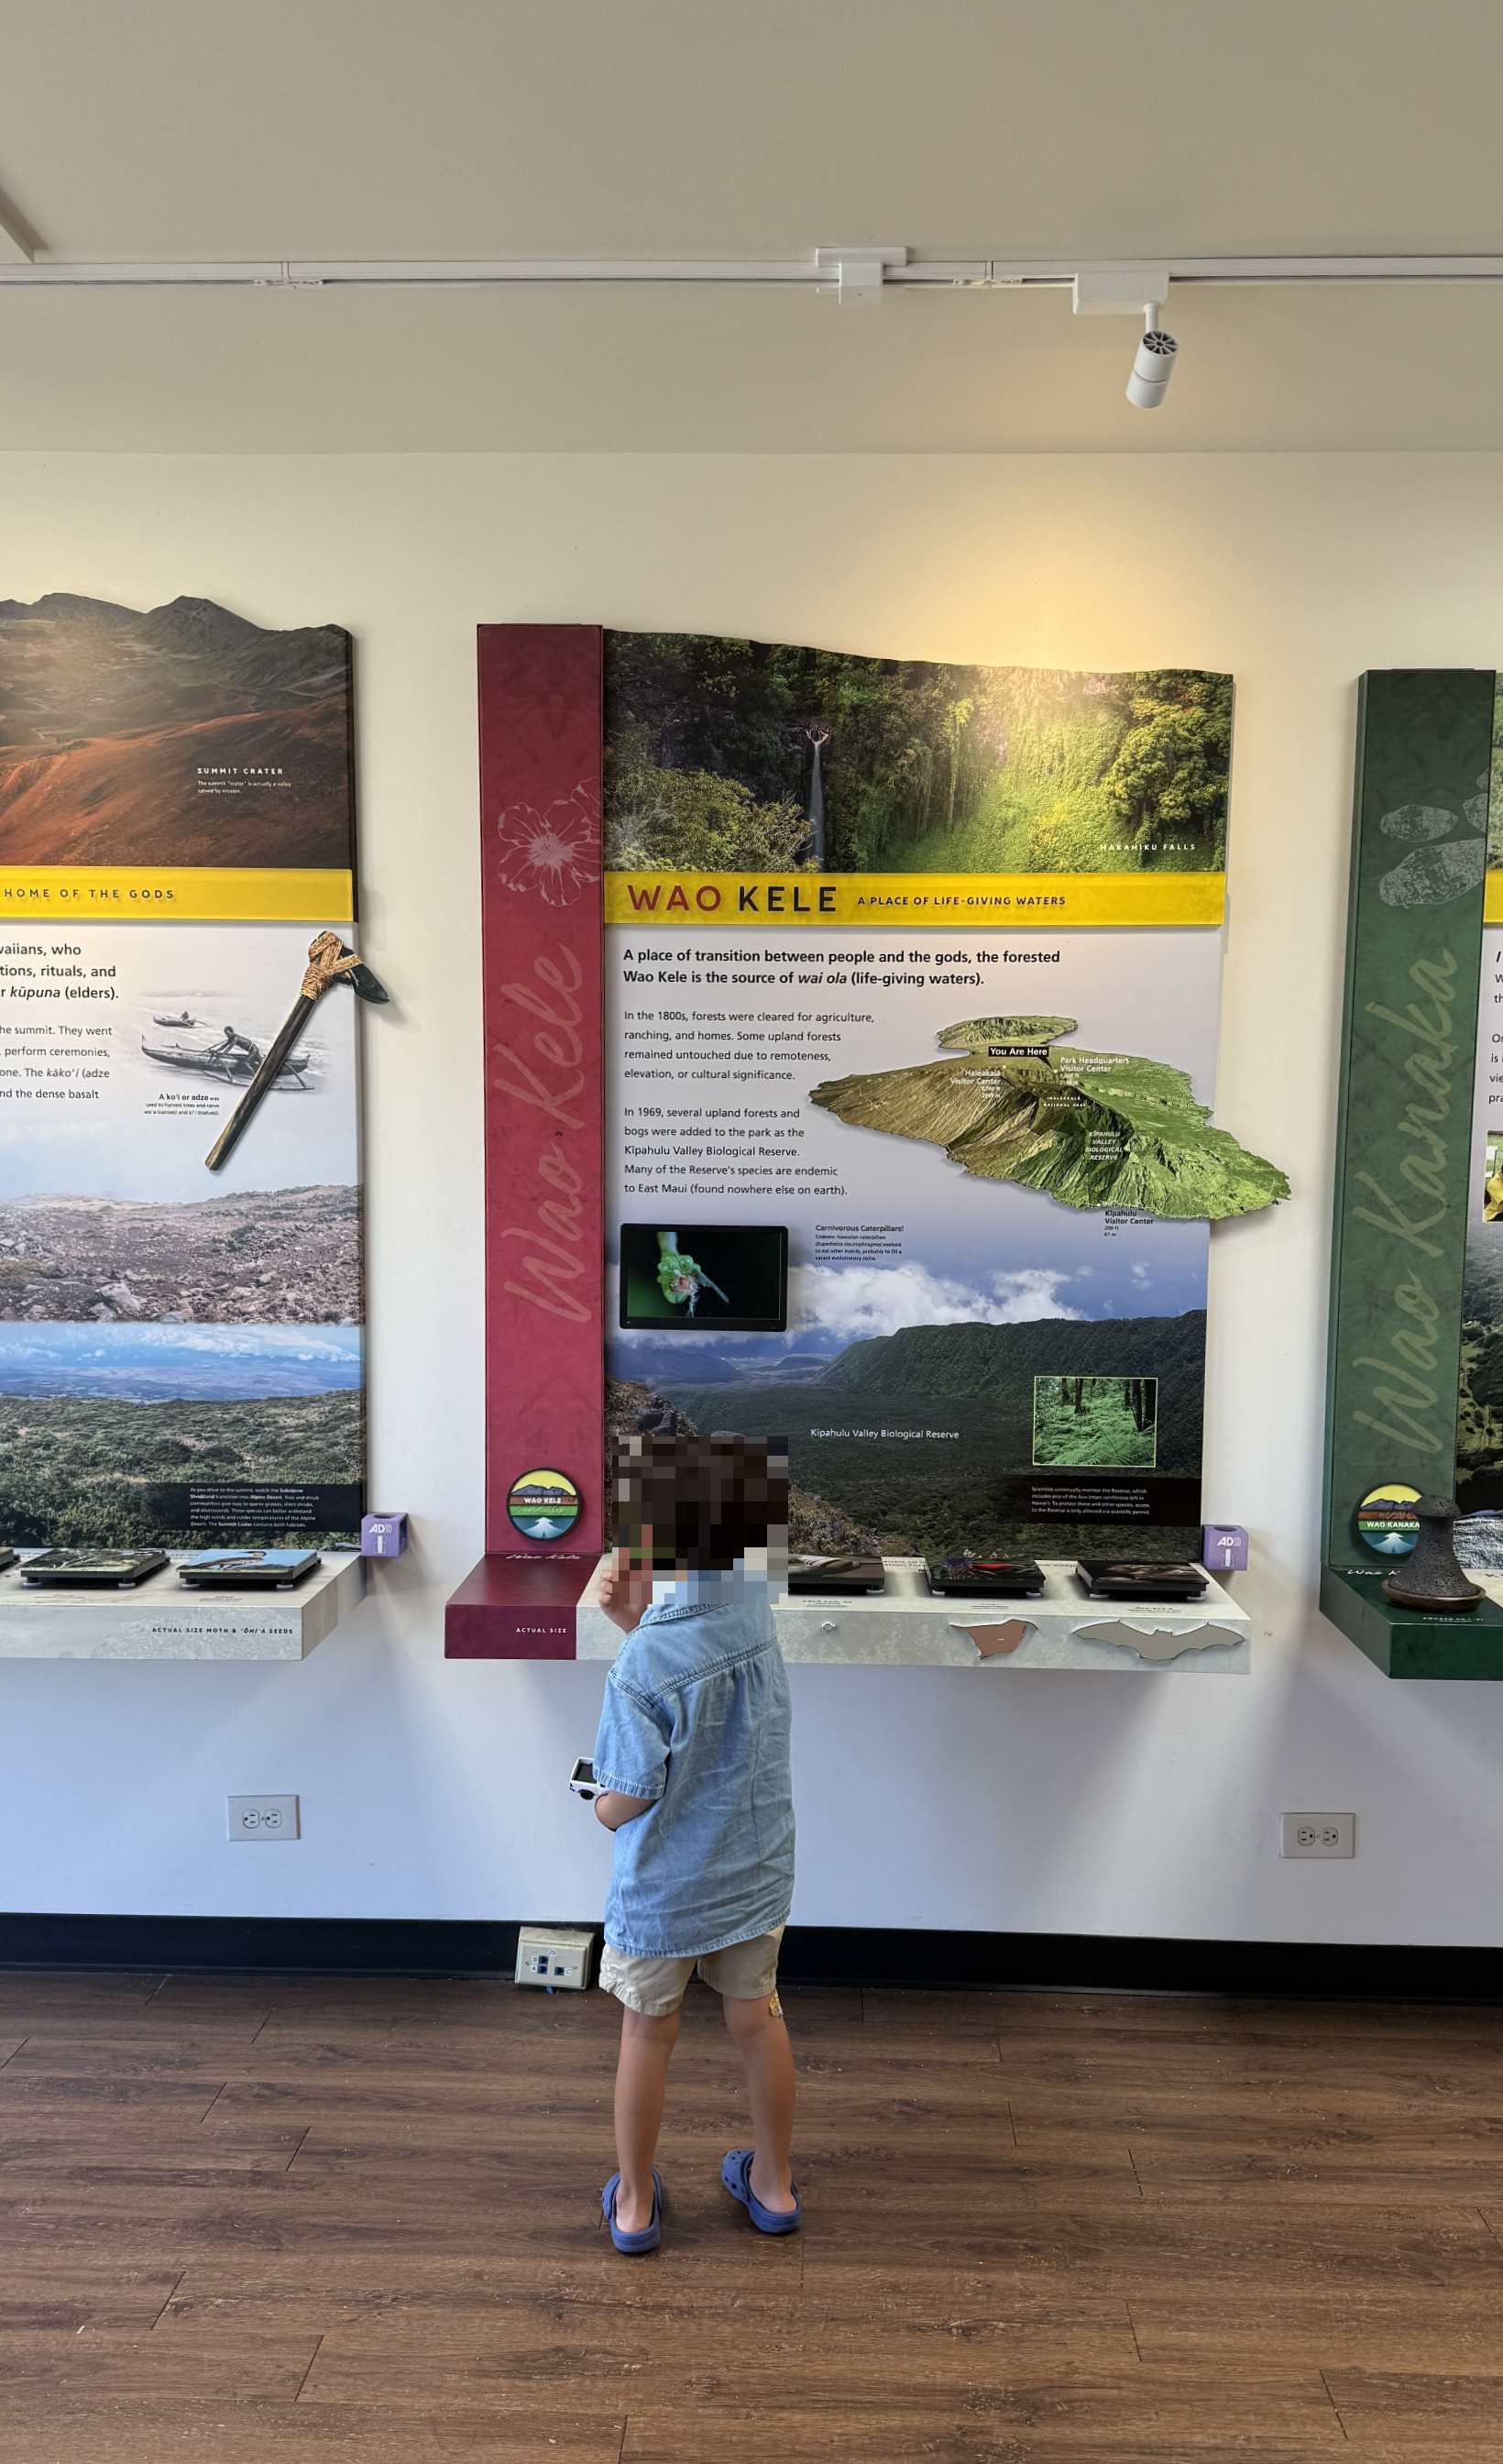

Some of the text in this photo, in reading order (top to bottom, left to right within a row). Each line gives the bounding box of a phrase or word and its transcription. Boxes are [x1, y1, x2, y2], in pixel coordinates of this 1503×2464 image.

[4, 888, 173, 898] HOME OF THE GODS
[627, 885, 836, 911] WAO KELE
[857, 896, 1065, 905] A PLACE OF LIFE-GIVING WATERS
[50, 942, 81, 955] who
[622, 948, 1059, 965] A place of transition between people and the gods, the forested
[40, 964, 86, 978] rituals,
[90, 964, 115, 977] and
[622, 970, 984, 987] Wao Kele is the source of wai ola (life-giving waters).
[9, 985, 60, 1000] kūpuna
[64, 985, 118, 1000] (elders).
[624, 1010, 874, 1025] In the 1800s, forests were cleared for agriculture,
[14, 1025, 55, 1035] summit.
[57, 1025, 82, 1037] They
[85, 1027, 112, 1035] went
[624, 1029, 841, 1043] ranching, and homes. Some upland forests
[5, 1045, 110, 1058] perform ceremonies,
[624, 1049, 830, 1062] remained untouched due to remoteness,
[990, 1047, 1047, 1055] You Are Here
[1079, 1056, 1129, 1065] Headquarters
[1059, 1063, 1112, 1072] Visitor Center
[623, 1068, 674, 1079] elevation,
[691, 1069, 730, 1079] cultural
[732, 1069, 795, 1082] significance.
[15, 1088, 32, 1098] the
[35, 1088, 65, 1098] dense
[68, 1089, 99, 1098] basalt
[624, 1106, 799, 1119] In 1969, several upland forests and
[494, 942, 592, 1323] Wao Kele
[624, 1126, 649, 1138] bogs
[679, 1126, 711, 1136] added
[714, 1128, 726, 1136] to
[728, 1127, 745, 1137] the
[748, 1128, 771, 1138] park
[786, 1128, 805, 1137] the
[673, 1145, 703, 1158] Valley
[706, 1146, 755, 1158] Biological
[758, 1147, 799, 1156] Reserve.
[624, 1164, 653, 1176] Many
[655, 1164, 666, 1173] of
[669, 1164, 686, 1173] the
[737, 1165, 773, 1177] species
[795, 1166, 838, 1175] endemic
[623, 1184, 635, 1193] to
[638, 1183, 658, 1193] East
[662, 1183, 687, 1193] Maui
[690, 1182, 724, 1194] (found
[727, 1184, 772, 1194] nowhere
[774, 1184, 795, 1194] else
[813, 1184, 847, 1196] earth).
[1352, 946, 1458, 1454] Wao Kanaka
[860, 1225, 904, 1233] Caterpillars!
[852, 1428, 878, 1439] Valley
[881, 1429, 923, 1440] Biological
[926, 1430, 959, 1438] Reserve
